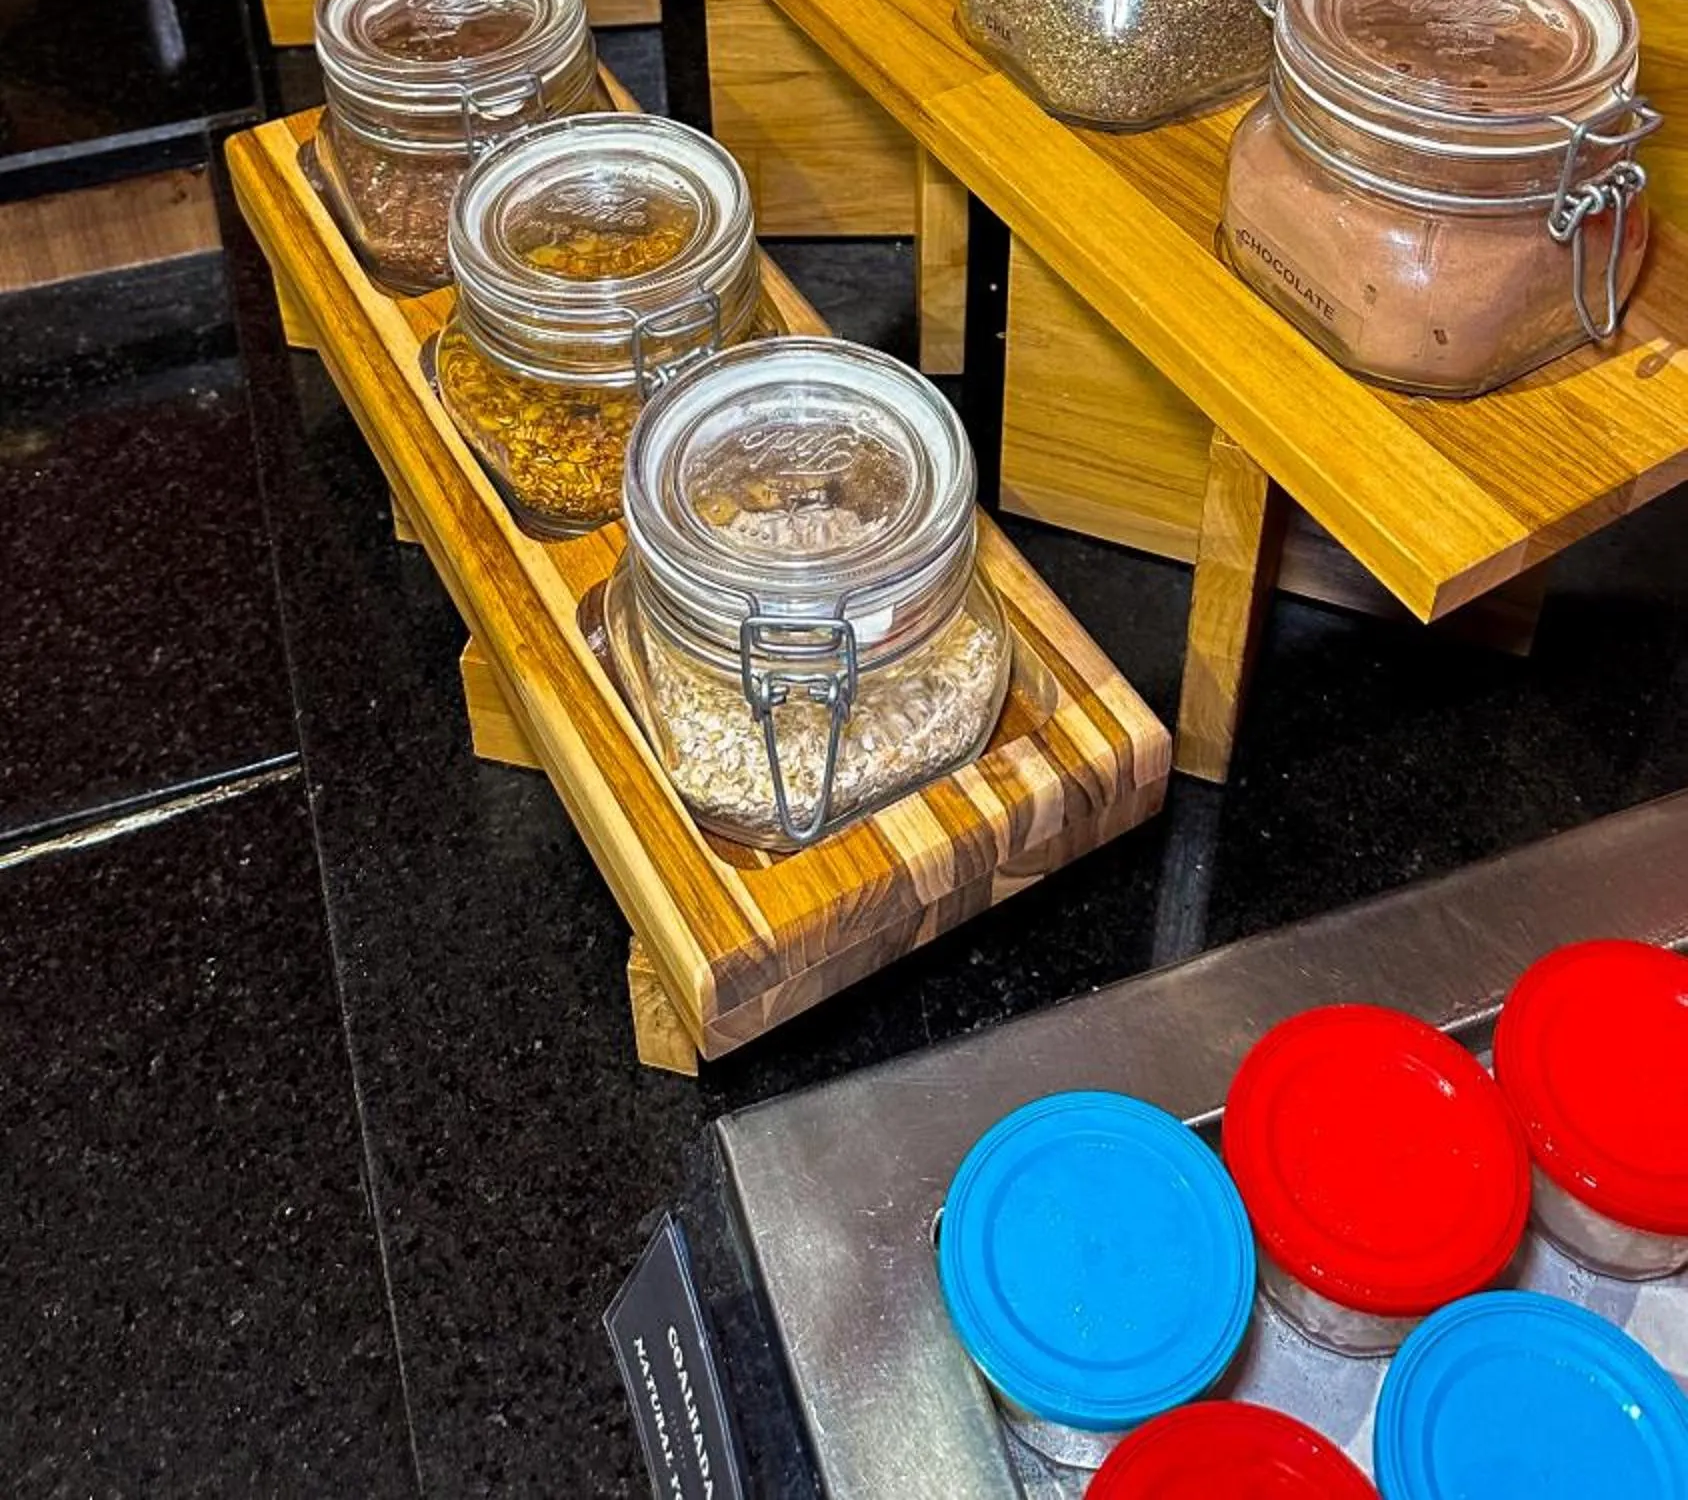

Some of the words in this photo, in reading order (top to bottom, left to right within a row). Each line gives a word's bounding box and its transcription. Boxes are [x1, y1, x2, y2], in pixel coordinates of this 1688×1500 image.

[1240, 228, 1335, 322] CHOCOLATE
[633, 1336, 675, 1469] NATURAL
[668, 1325, 714, 1500] COALHADA
